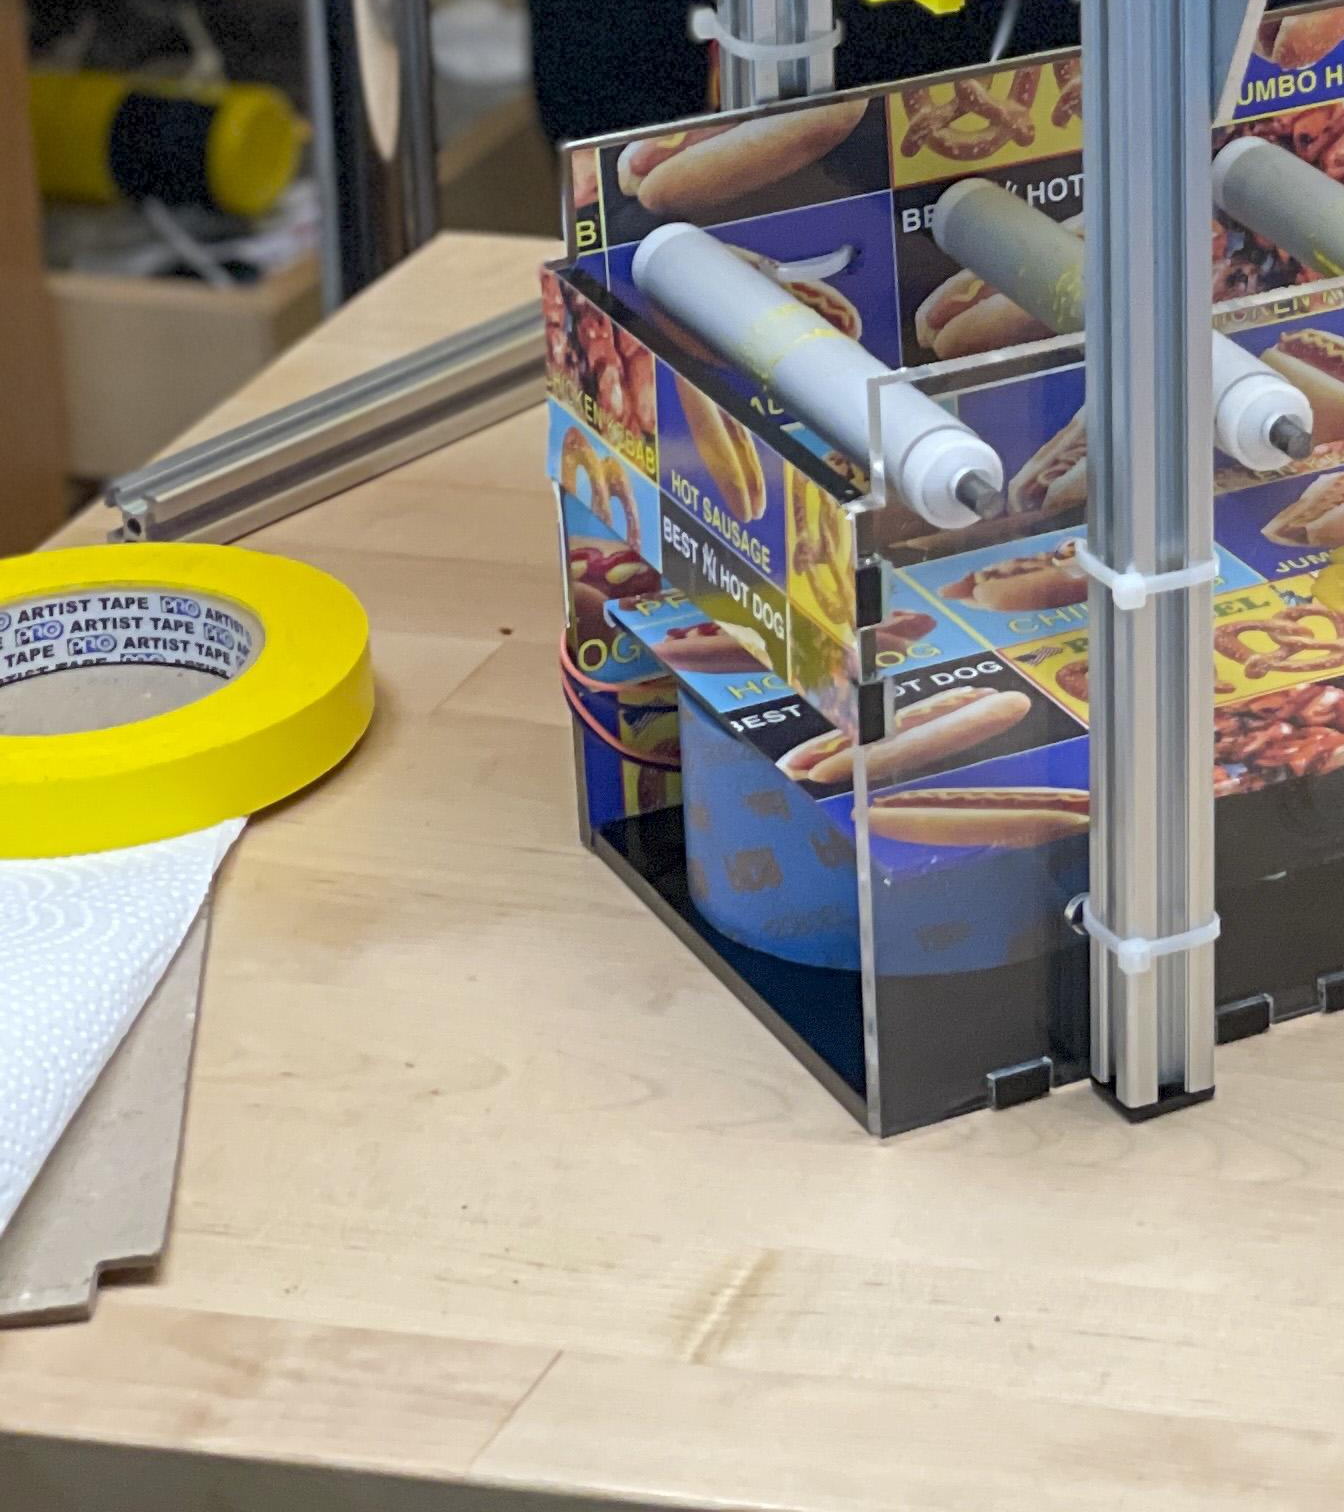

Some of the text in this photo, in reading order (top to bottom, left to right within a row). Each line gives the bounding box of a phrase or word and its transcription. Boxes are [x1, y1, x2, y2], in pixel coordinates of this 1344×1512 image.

[1238, 70, 1317, 106] UMBO
[901, 173, 1085, 233] BE HOT
[671, 470, 773, 575] HOT SAUSAGE
[1275, 548, 1333, 574] JUM
[662, 516, 699, 565] BEST
[720, 569, 750, 606] HOT
[752, 594, 786, 641] DOG
[17, 599, 91, 625] ARTIST
[98, 596, 150, 611] TAPE
[70, 616, 144, 634] ARTIST
[150, 617, 196, 635] TAPE
[1008, 601, 1088, 635] CHI
[3, 644, 56, 669] TAPE
[122, 636, 190, 653] ARTIST
[194, 642, 232, 666] TAPE
[577, 631, 641, 673] OG
[875, 642, 942, 668] OG
[929, 660, 1004, 687] DOG
